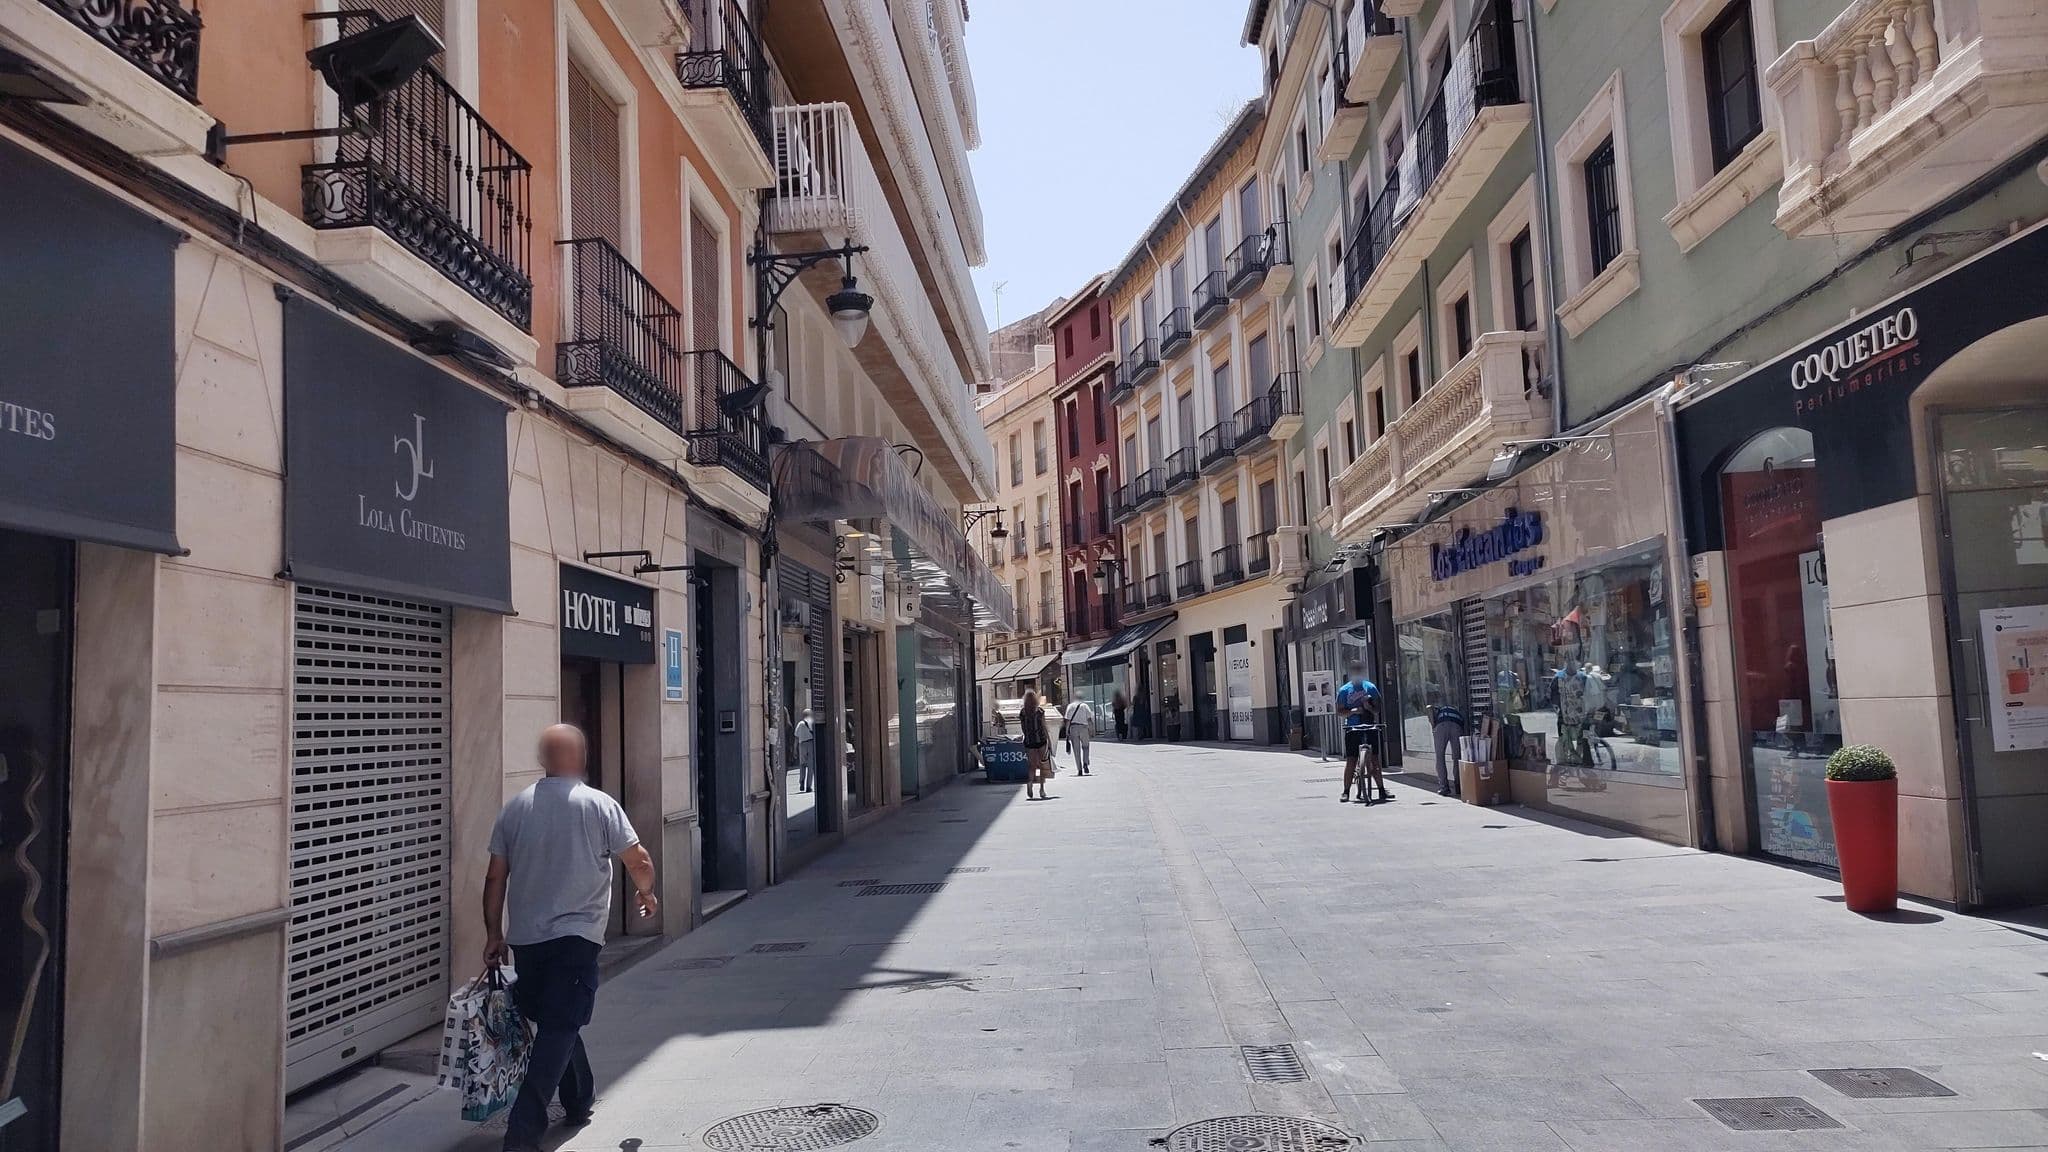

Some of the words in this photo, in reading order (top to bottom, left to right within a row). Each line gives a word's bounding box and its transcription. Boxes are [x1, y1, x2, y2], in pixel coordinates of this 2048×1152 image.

[1791, 307, 1918, 390] COQUETEO
[0, 402, 56, 440] TES
[563, 589, 620, 636] HOTEL
[670, 636, 678, 668] H
